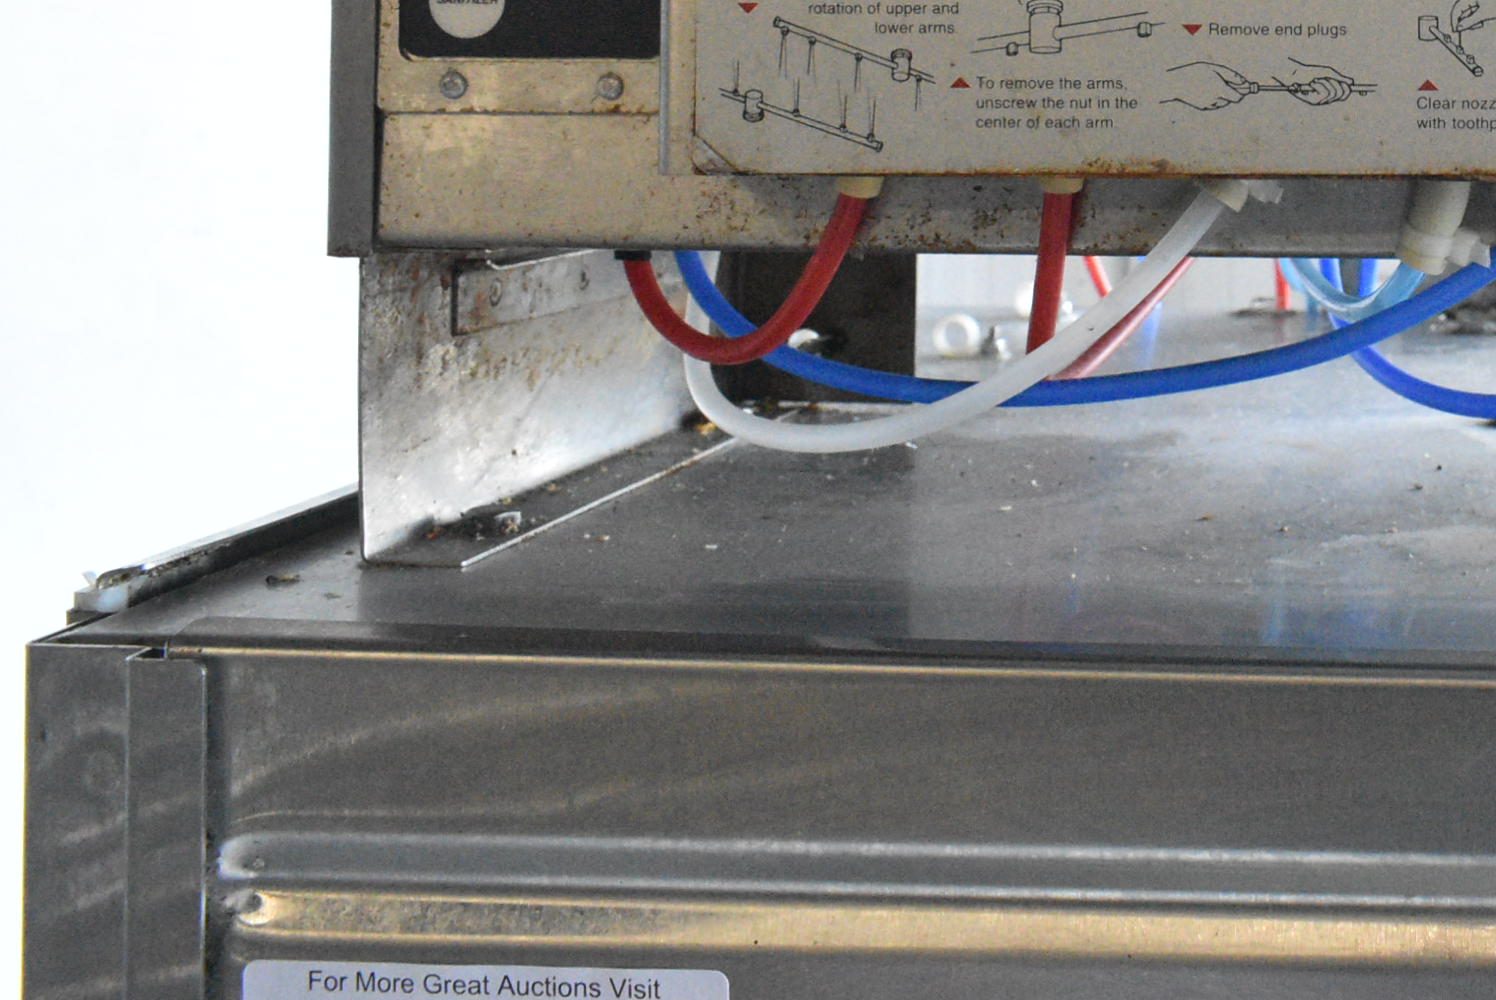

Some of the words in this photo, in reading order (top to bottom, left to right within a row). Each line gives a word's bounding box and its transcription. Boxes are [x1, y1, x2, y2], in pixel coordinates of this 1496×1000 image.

[808, 3, 862, 14] rotation
[867, 2, 881, 14] of
[886, 5, 927, 17] upper
[932, 2, 959, 14] and
[875, 22, 914, 34] lower
[1209, 22, 1269, 36] Remove
[1275, 24, 1302, 36] end
[976, 76, 995, 89] To
[1000, 79, 1054, 89] remove
[1059, 77, 1081, 89] the
[976, 99, 1037, 109] unscrew
[1042, 97, 1064, 109] the
[1070, 98, 1092, 109] nut
[1098, 99, 1110, 109] in
[1115, 97, 1138, 109] the
[1416, 96, 1456, 110] Clear
[976, 117, 1021, 128] center
[1026, 115, 1041, 130] of
[1045, 116, 1080, 131] each
[1417, 117, 1446, 129] with
[309, 970, 347, 992] For
[356, 971, 414, 993] More
[423, 974, 490, 995] Great
[497, 975, 601, 998] Auctions
[609, 978, 660, 1000] Visit
